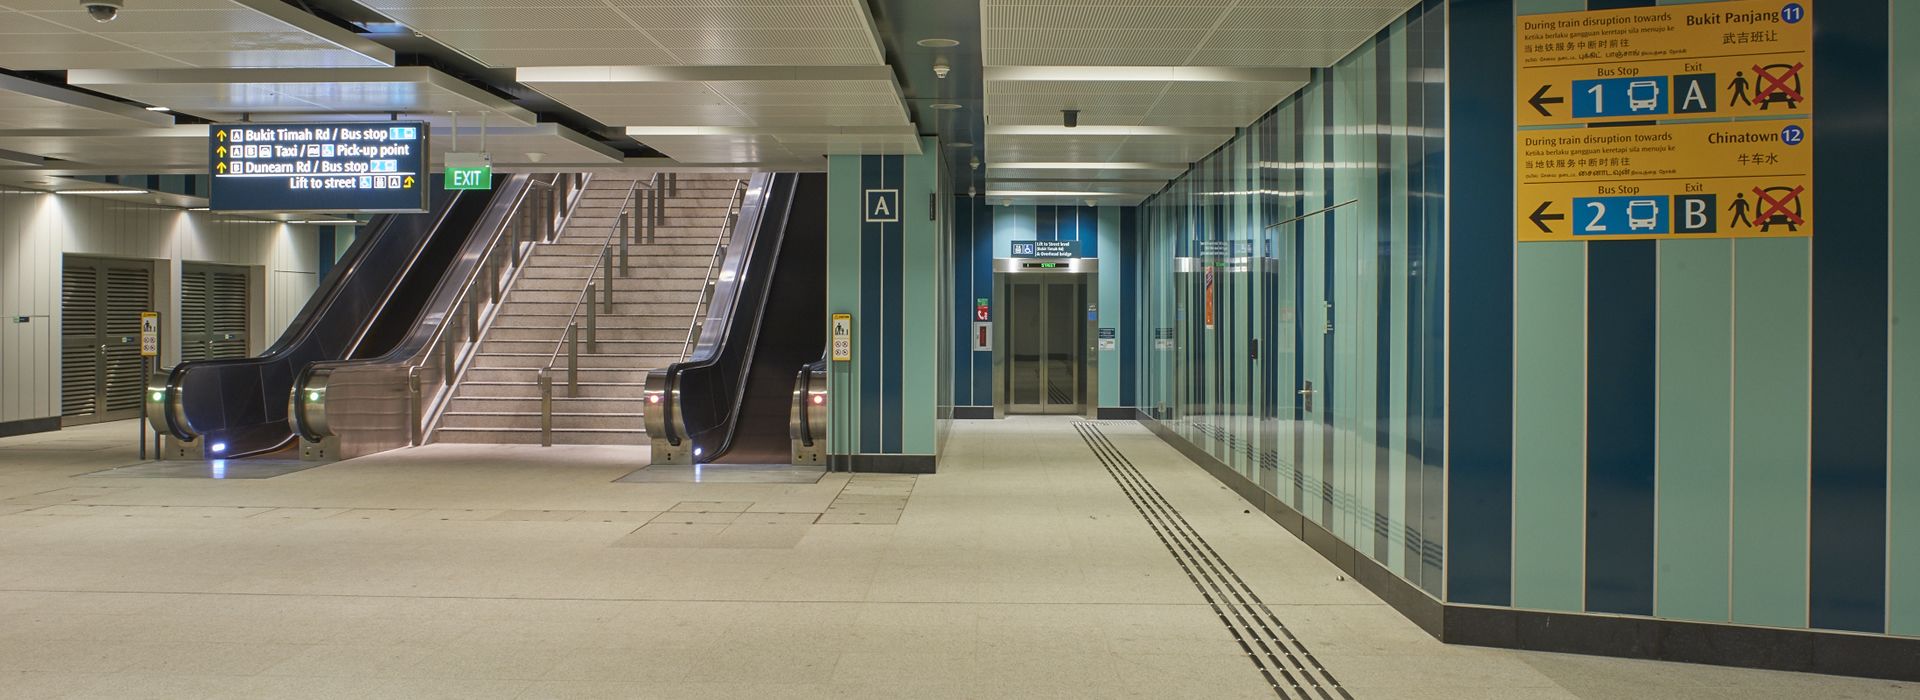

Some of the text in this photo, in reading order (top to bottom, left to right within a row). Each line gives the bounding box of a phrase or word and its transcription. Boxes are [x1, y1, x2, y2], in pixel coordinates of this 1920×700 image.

[1524, 13, 1672, 30] During train disruption towards
[1686, 8, 1800, 26] Bukit Panjang 11
[1723, 30, 1778, 44] 武吉班让
[1525, 39, 1630, 52] 当地铁服务中断时前往
[1598, 66, 1639, 77] Bus Stop
[1685, 62, 1702, 71] Exit
[1588, 83, 1603, 113] 1
[1682, 80, 1707, 110] A
[246, 128, 275, 140] Bukit
[277, 128, 312, 140] Timah
[316, 128, 329, 140] Rd
[333, 128, 338, 140] /
[341, 128, 362, 140] Bus
[363, 129, 387, 142] stop
[1525, 132, 1672, 147] During train disruption towards
[1708, 129, 1801, 144] Chinatown 12
[275, 145, 297, 157] Taxi
[300, 145, 305, 157] /
[337, 144, 377, 157] Pick-up
[380, 143, 409, 157] point
[1526, 157, 1630, 168] 当地铁服务中断时前往
[1737, 152, 1778, 166] 牛车水
[246, 162, 293, 173] Dunearn
[296, 161, 310, 173] Rd
[313, 161, 319, 173] /
[322, 161, 342, 172] Bus
[344, 161, 368, 173] stop
[290, 177, 308, 188] Lift
[311, 178, 322, 188] to
[325, 177, 356, 188] street
[454, 171, 481, 185] EXIT
[1598, 184, 1640, 195] Bus Stop
[1685, 183, 1703, 192] Exit
[875, 196, 890, 215] A
[1585, 202, 1607, 231] 2
[1685, 198, 1707, 229] B
